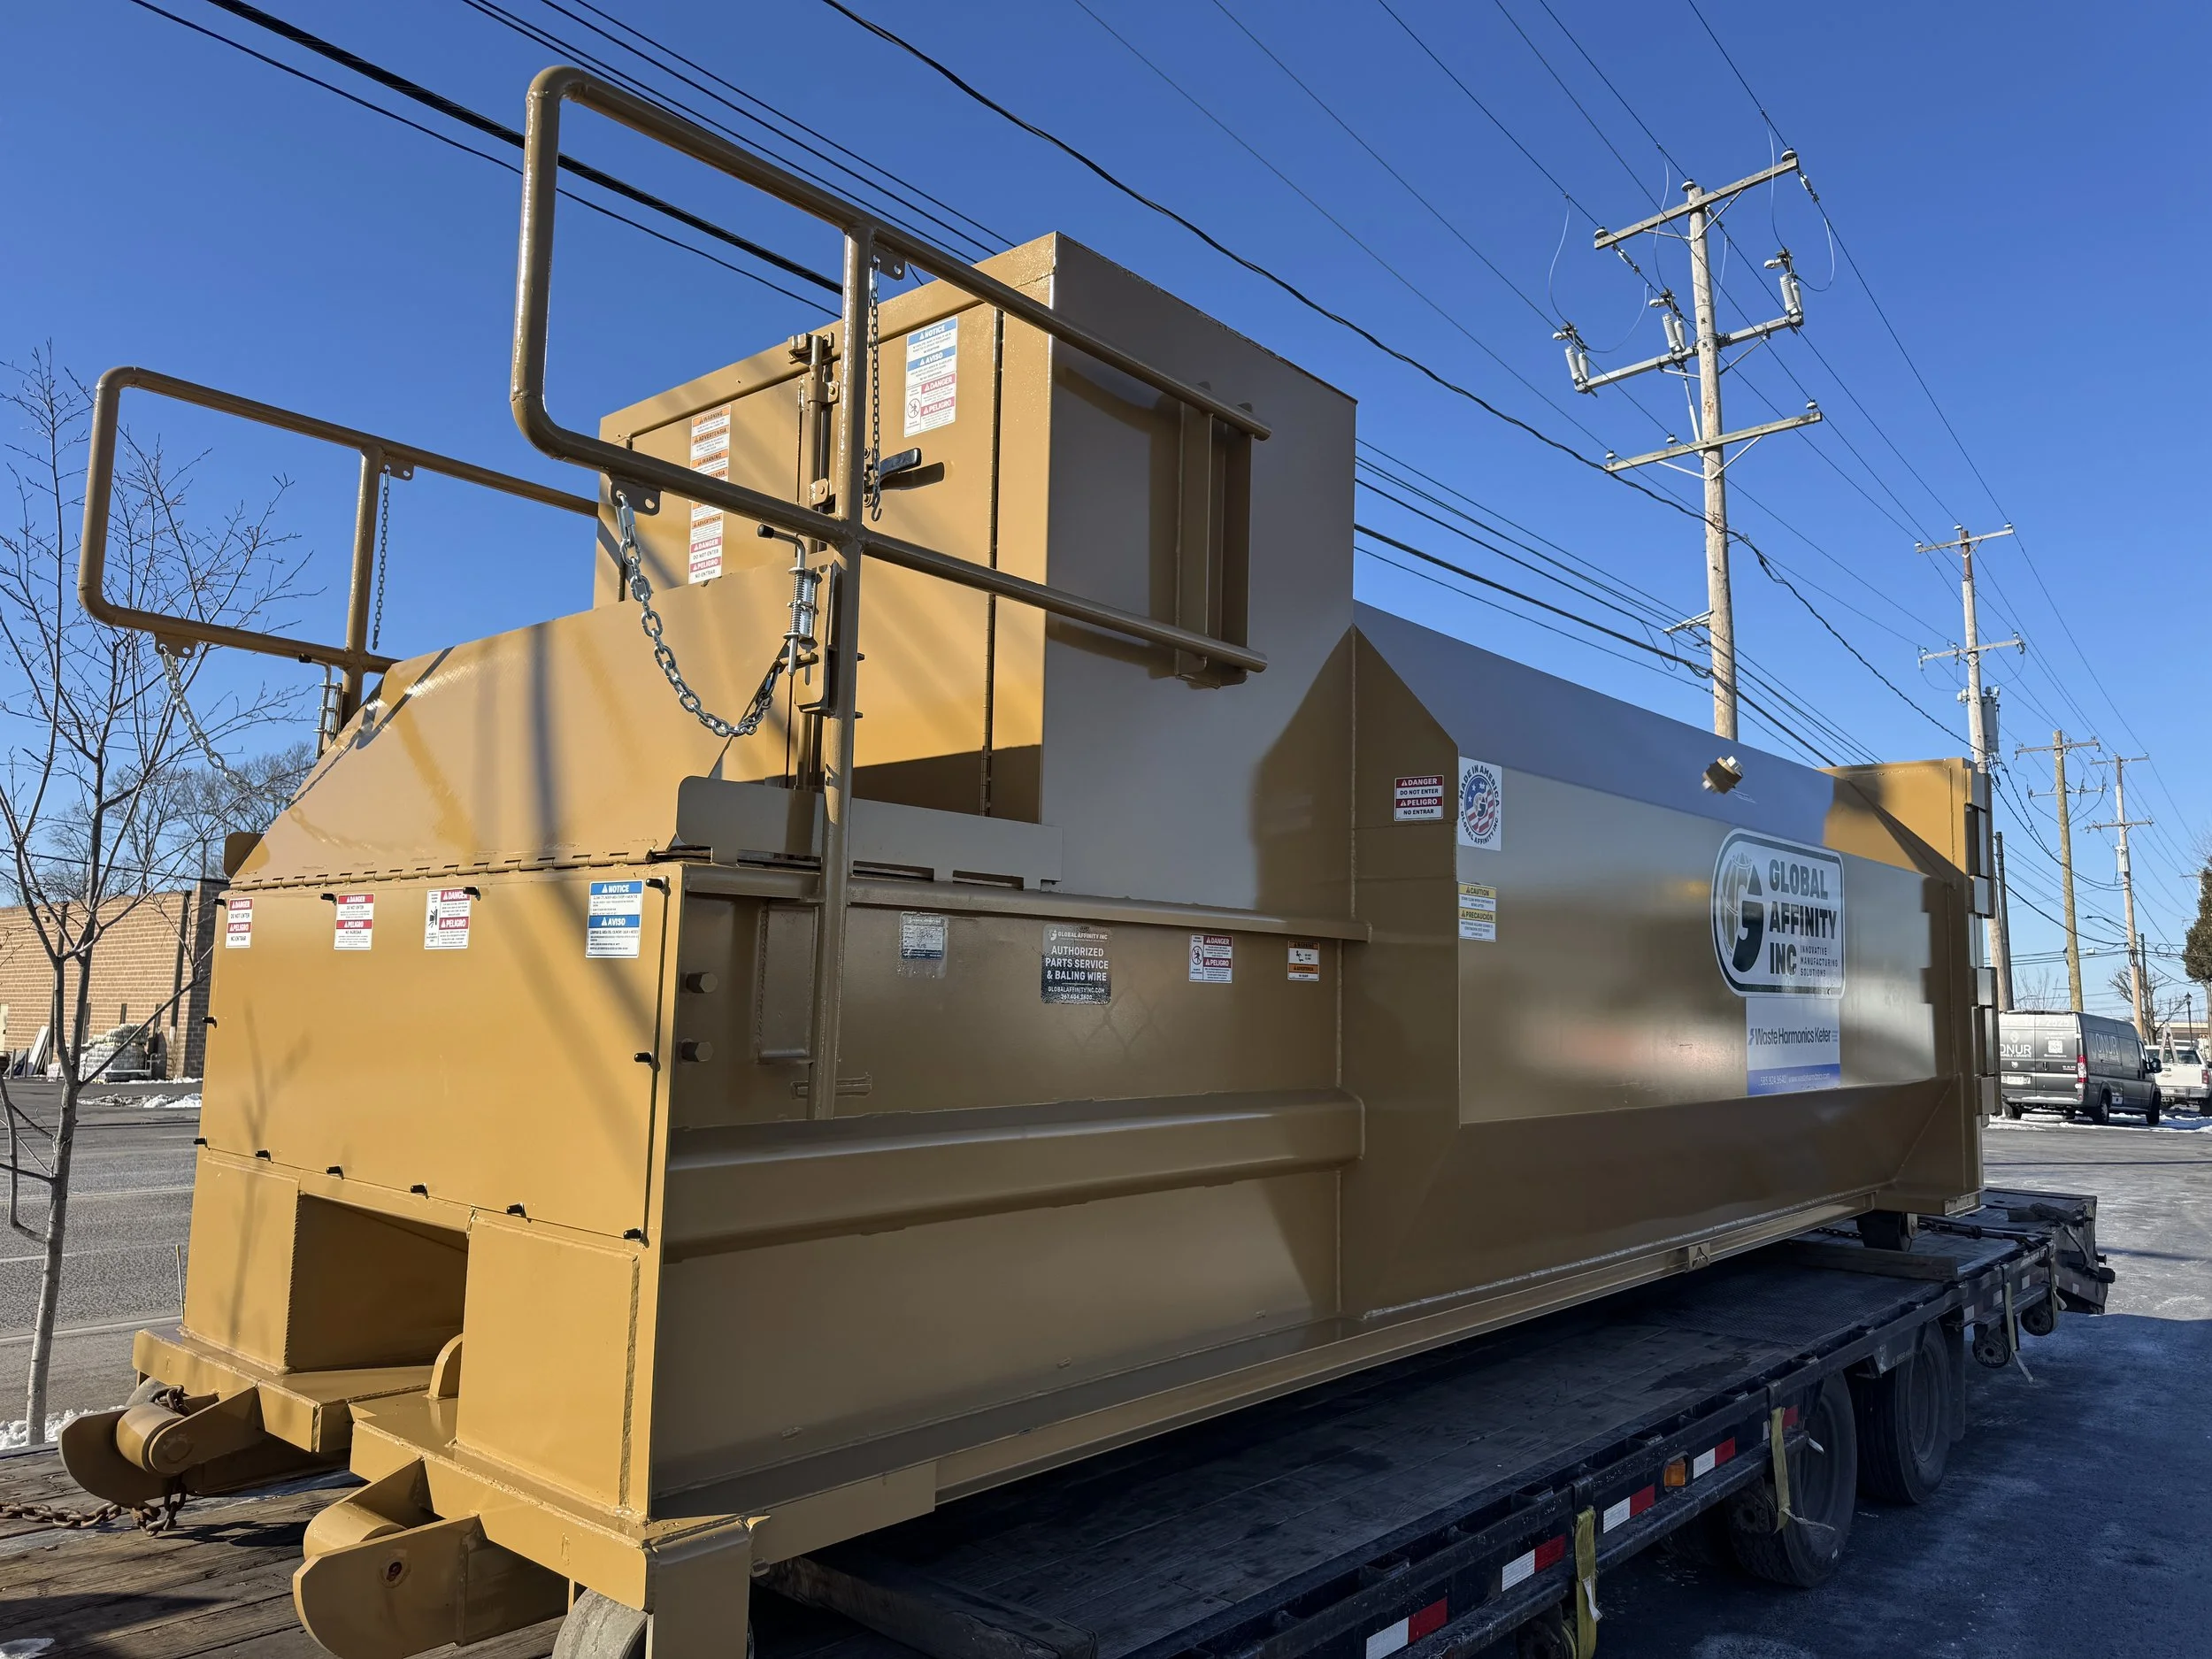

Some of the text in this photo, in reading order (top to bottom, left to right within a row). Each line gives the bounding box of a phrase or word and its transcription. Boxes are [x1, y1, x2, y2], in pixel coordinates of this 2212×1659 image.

[925, 325, 946, 339] NOTICE
[925, 352, 943, 365] AVISO
[929, 376, 953, 389] DANGER
[929, 399, 952, 413] PELIGRO
[703, 411, 723, 422] WARNING
[701, 453, 722, 465] WARNING
[698, 538, 718, 549] DANGER
[697, 558, 718, 570] PELIGRO
[1459, 764, 1500, 807] MADE IN AMERICA
[1460, 810, 1474, 841] GLOBAL
[1473, 832, 1494, 845] AFFINITY
[1769, 858, 1828, 900] GLOBAL
[608, 884, 630, 893] NOTICE
[1470, 887, 1490, 896] CAUTION
[448, 891, 468, 900] DANGER
[607, 918, 626, 926] AVISO
[1465, 911, 1494, 921] PRECAUCIÓN
[1769, 901, 1838, 940] AFFINITY
[233, 923, 250, 932] PELIGRO
[446, 918, 466, 927] PELIGRO
[1051, 945, 1104, 956] AUTHORIZED
[1800, 944, 1827, 956] INNOVATIVE
[1045, 957, 1109, 969] PARTS SERVICE
[1770, 942, 1797, 976] INC
[1800, 956, 1839, 967] MANUFACTURING
[1047, 970, 1107, 981] & BALING WIRE
[1800, 968, 1826, 978] SOLUTIONS
[1755, 1028, 1778, 1045] Waste
[1778, 1027, 1815, 1044] Harmonics
[1815, 1027, 1832, 1043] Keter
